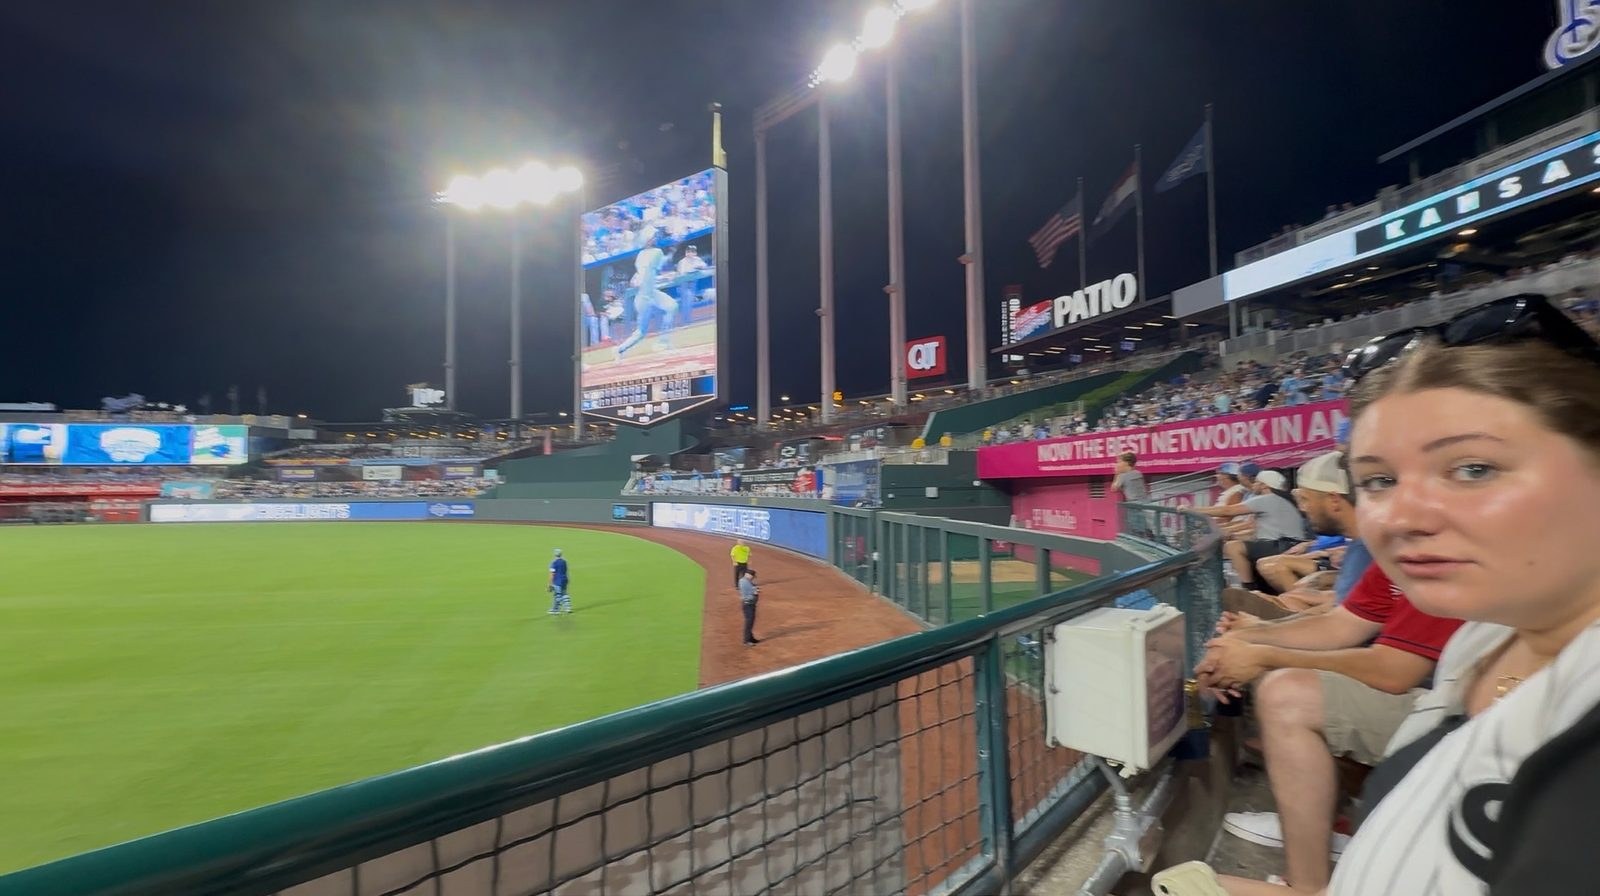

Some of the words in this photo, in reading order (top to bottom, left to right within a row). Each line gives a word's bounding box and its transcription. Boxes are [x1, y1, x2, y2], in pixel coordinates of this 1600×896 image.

[1054, 273, 1137, 328] PATIO
[908, 341, 939, 370] QT
[1038, 443, 1071, 462] NOW
[1073, 438, 1103, 460] THE
[1106, 433, 1149, 456] BEST
[1152, 419, 1267, 454] NETWORK
[1271, 414, 1302, 445] IN
